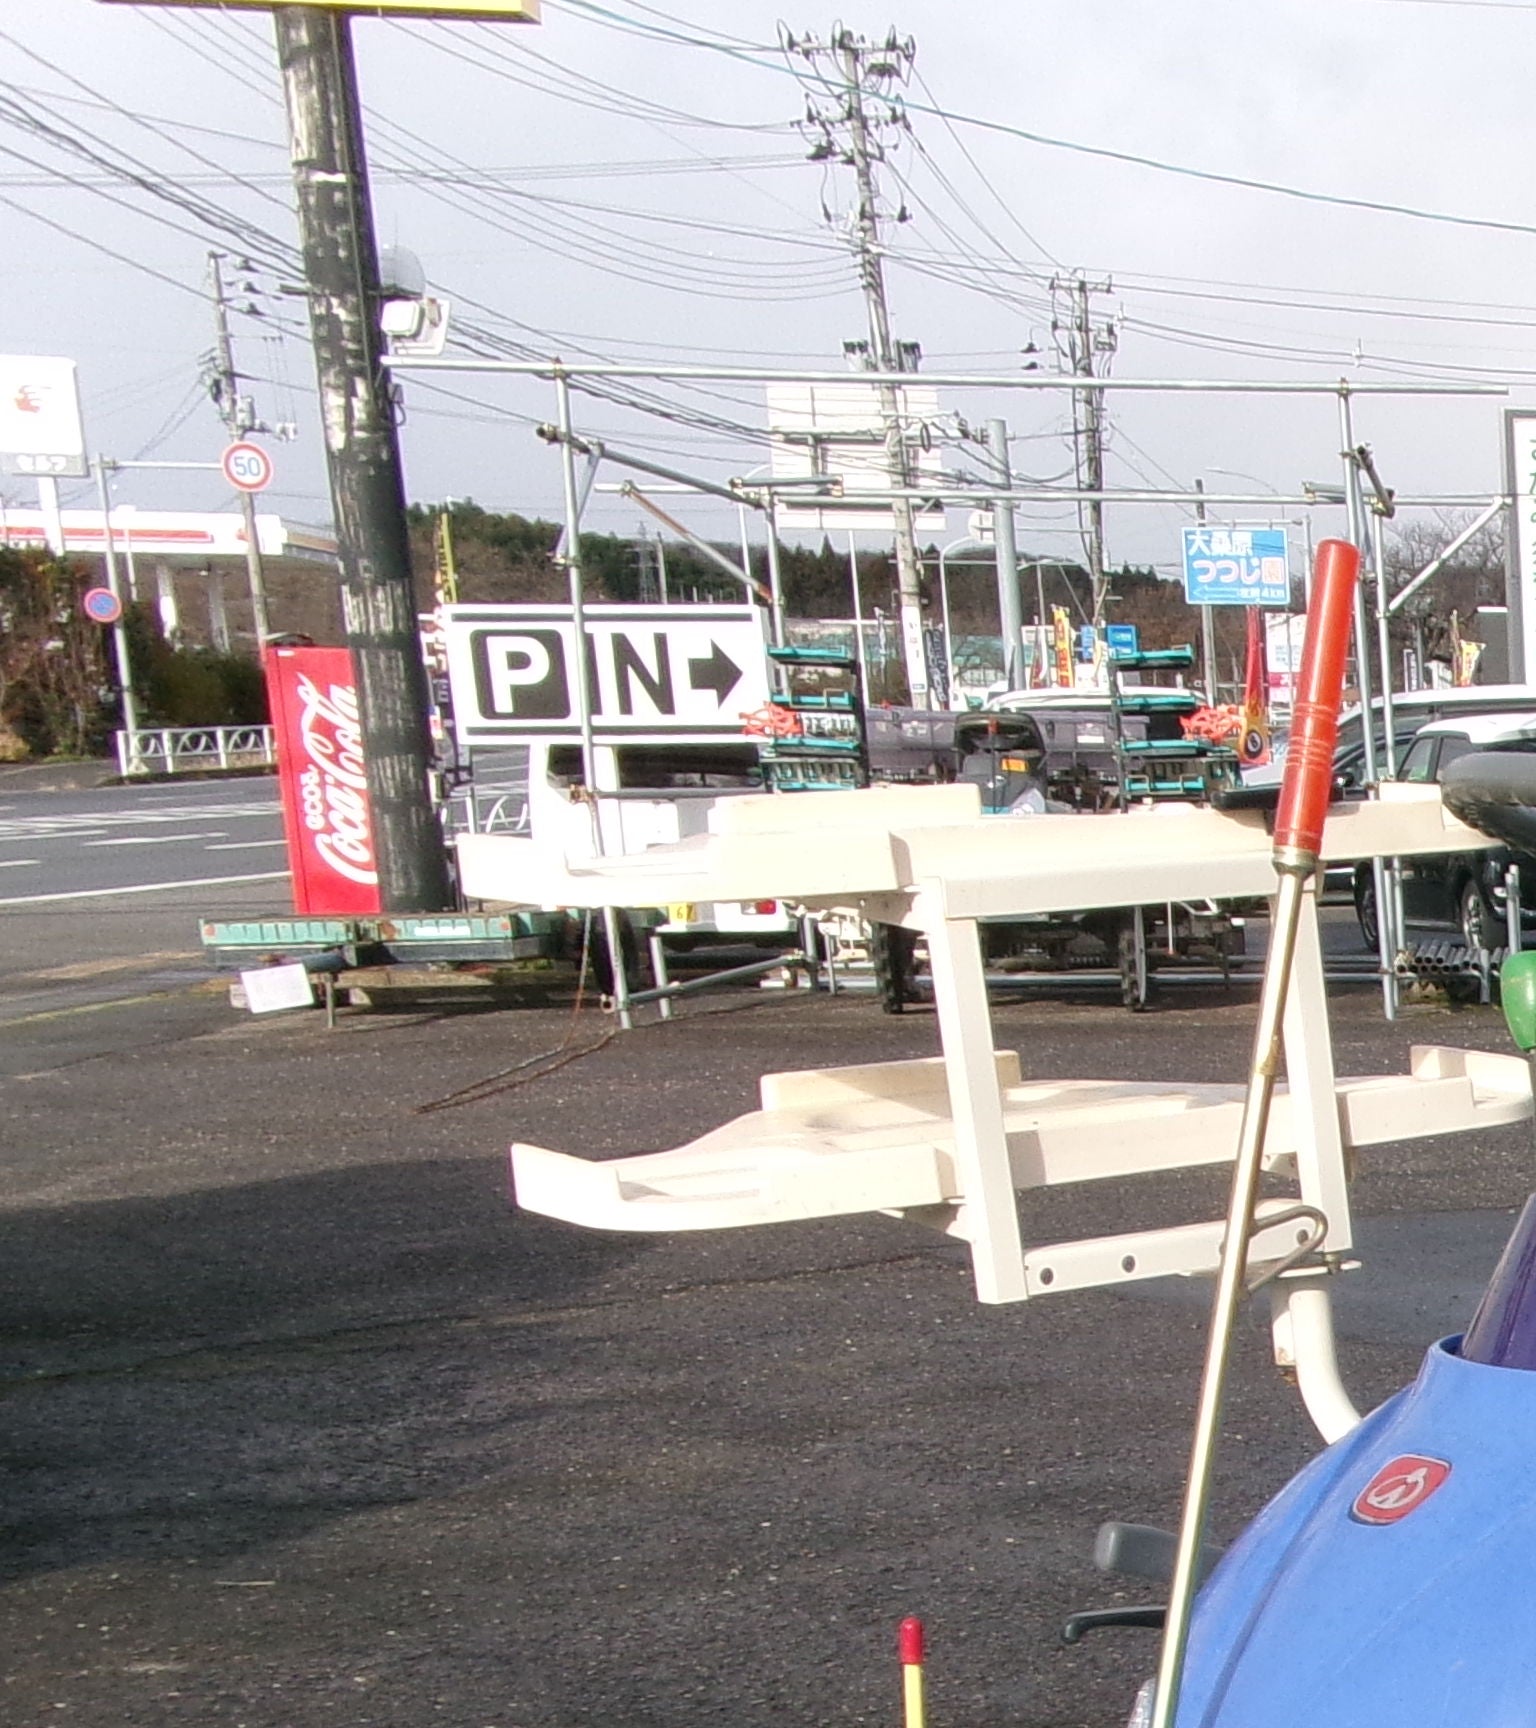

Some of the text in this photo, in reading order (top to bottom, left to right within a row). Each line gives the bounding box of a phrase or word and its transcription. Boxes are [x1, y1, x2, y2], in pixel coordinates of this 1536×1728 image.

[233, 456, 261, 477] 50
[486, 632, 677, 715] P IN
[296, 671, 378, 884] Coca-Cola
